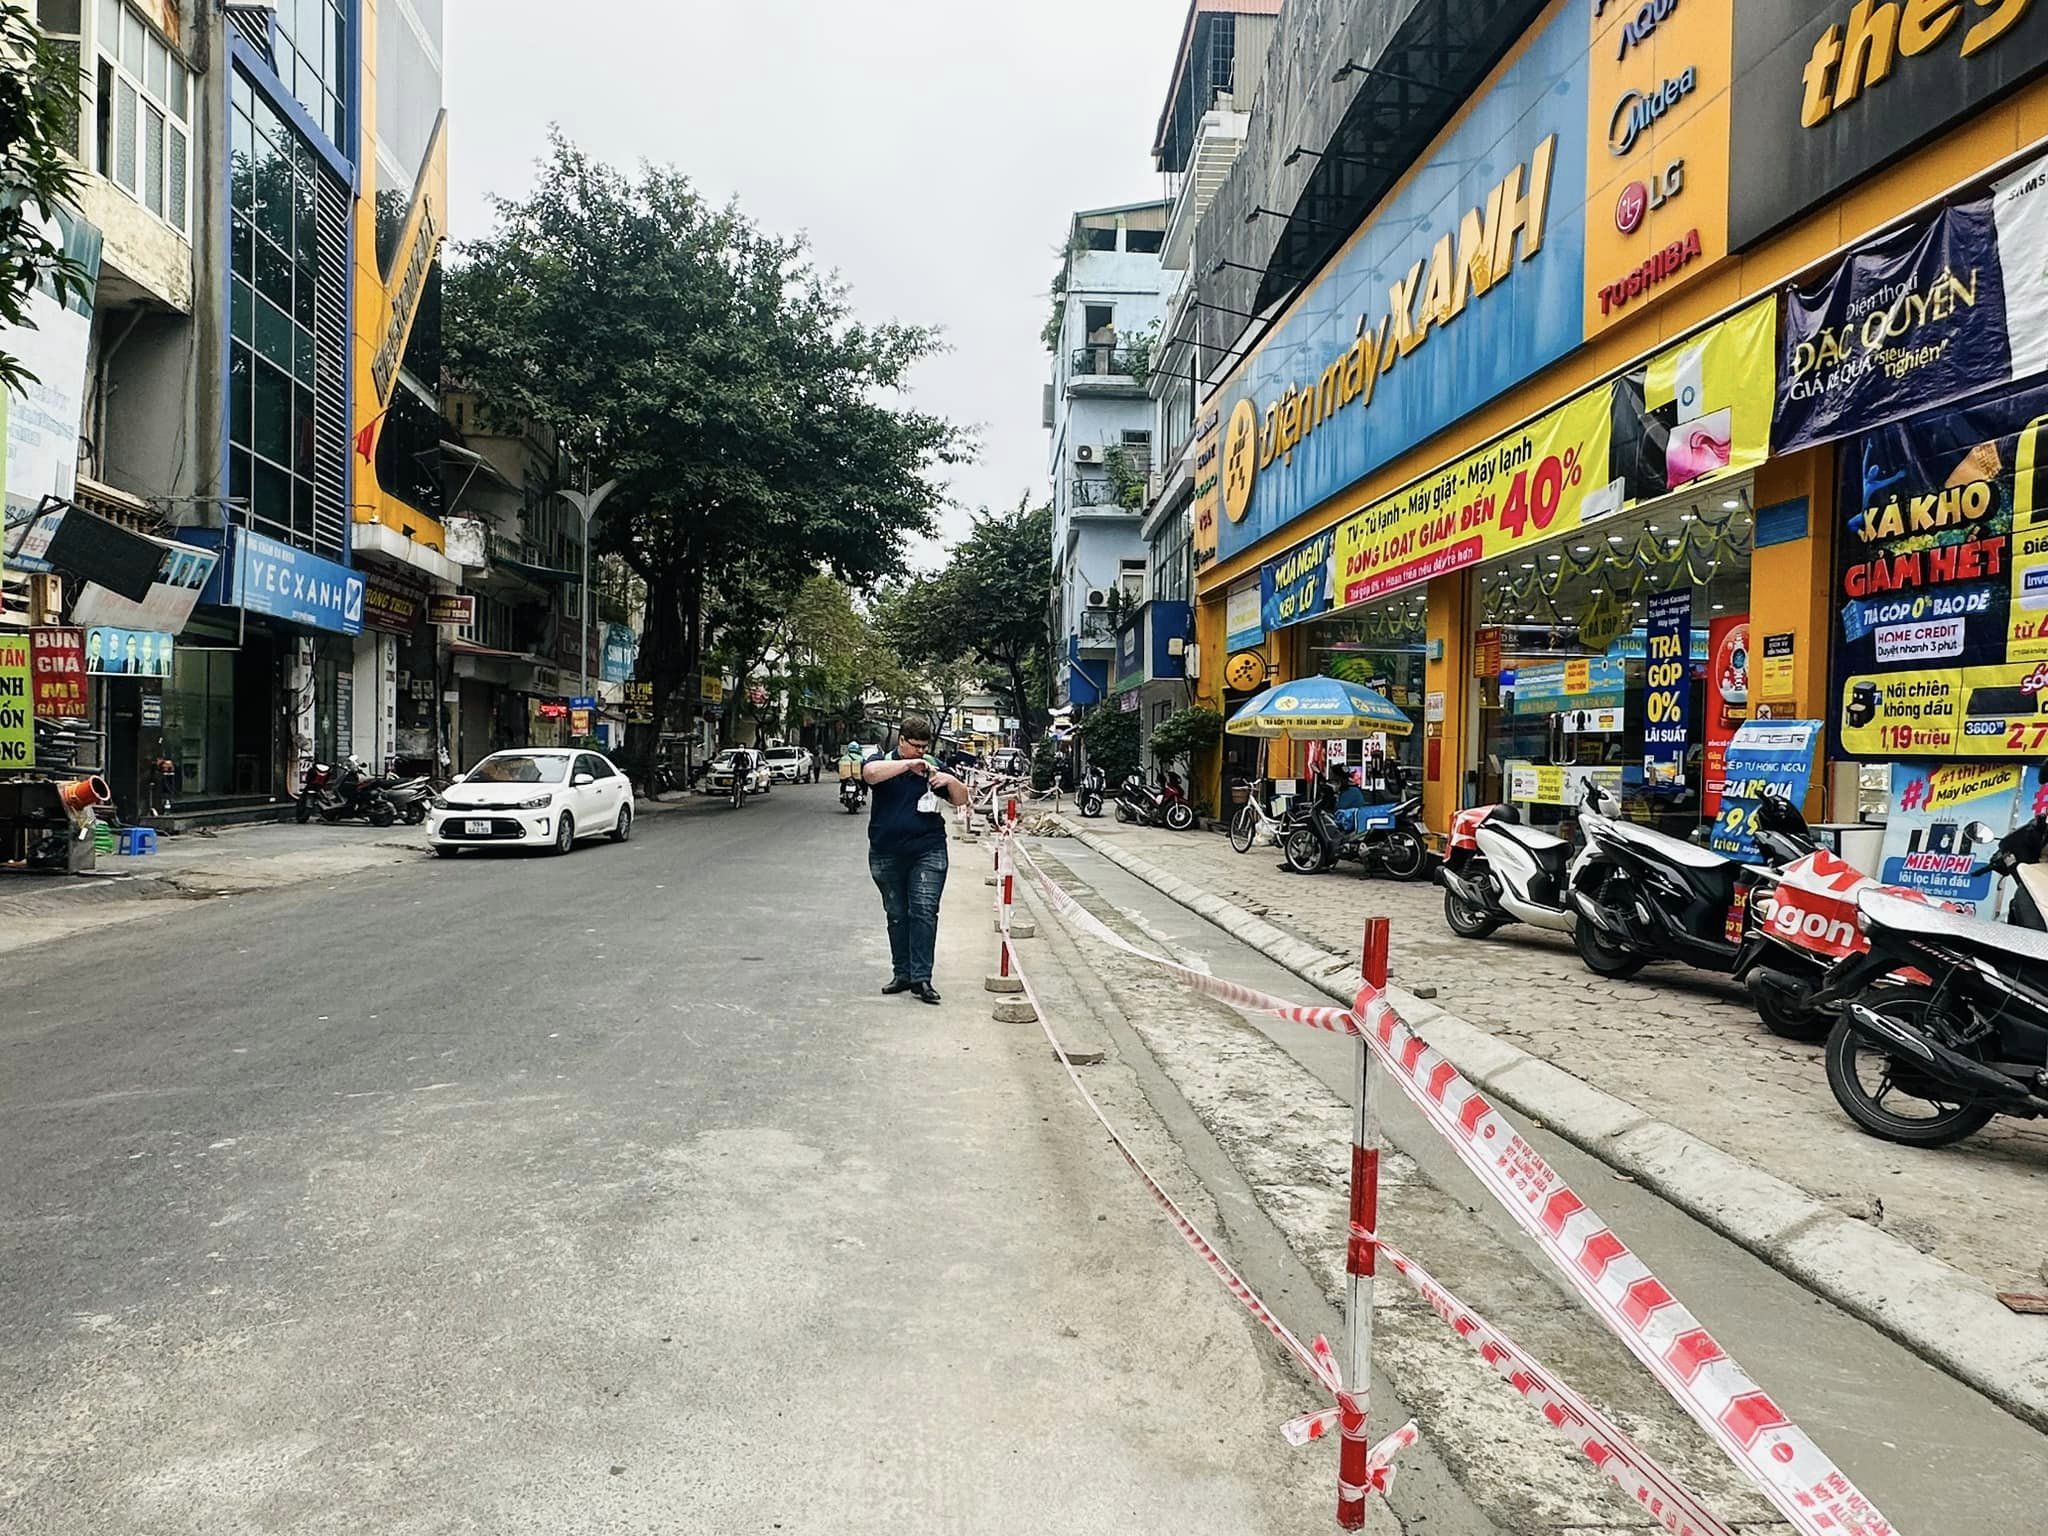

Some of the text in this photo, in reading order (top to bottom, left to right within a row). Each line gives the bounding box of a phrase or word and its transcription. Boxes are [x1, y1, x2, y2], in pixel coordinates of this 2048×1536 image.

[1608, 66, 1697, 156] Midea
[1649, 158, 1685, 210] LG
[1598, 228, 1702, 316] TOSHIBA
[1259, 133, 1558, 470] Điện máy XANH
[1791, 265, 1979, 377] ĐẶC QUYỀN
[1789, 372, 1825, 401] GIÁ
[1347, 524, 1359, 544] TV
[1378, 503, 1400, 534] lạnh
[1408, 485, 1431, 513] Máy
[1433, 474, 1458, 507] giặt
[1467, 454, 1497, 487] Máy
[1499, 436, 1533, 477] lạnh
[1383, 528, 1416, 563] LOẠT
[1419, 507, 1457, 548] GIẢM
[1460, 486, 1496, 532] ĐẾN
[1500, 440, 1585, 539] 40%
[1858, 480, 1991, 543] XẢ KHO
[1275, 535, 1328, 593] MUA NGAY
[1844, 525, 2006, 598] GIẢM HẾT
[253, 559, 342, 611] YECXANH
[1879, 601, 1910, 622] GÓP
[1933, 595, 1966, 616] BAO
[35, 629, 80, 649] BÚN
[1650, 627, 1683, 659] TRẢ
[1878, 624, 1959, 645] HOME CREDIT
[1878, 636, 1959, 658] Duyệt nhanh 3 phút
[1647, 657, 1683, 688] GÓP
[1886, 680, 1949, 699] Nồi chiên
[1647, 690, 1681, 723] 0%
[1884, 697, 1953, 719] không dầu
[1645, 727, 1687, 743] LÃI SUẤT
[1880, 724, 1951, 752] 1,19 triệu
[1722, 779, 1746, 797] GIÁ
[1935, 769, 2012, 802] Máy lọc nước
[1902, 851, 1943, 873] MIỄN
[1913, 871, 1929, 886] lọc
